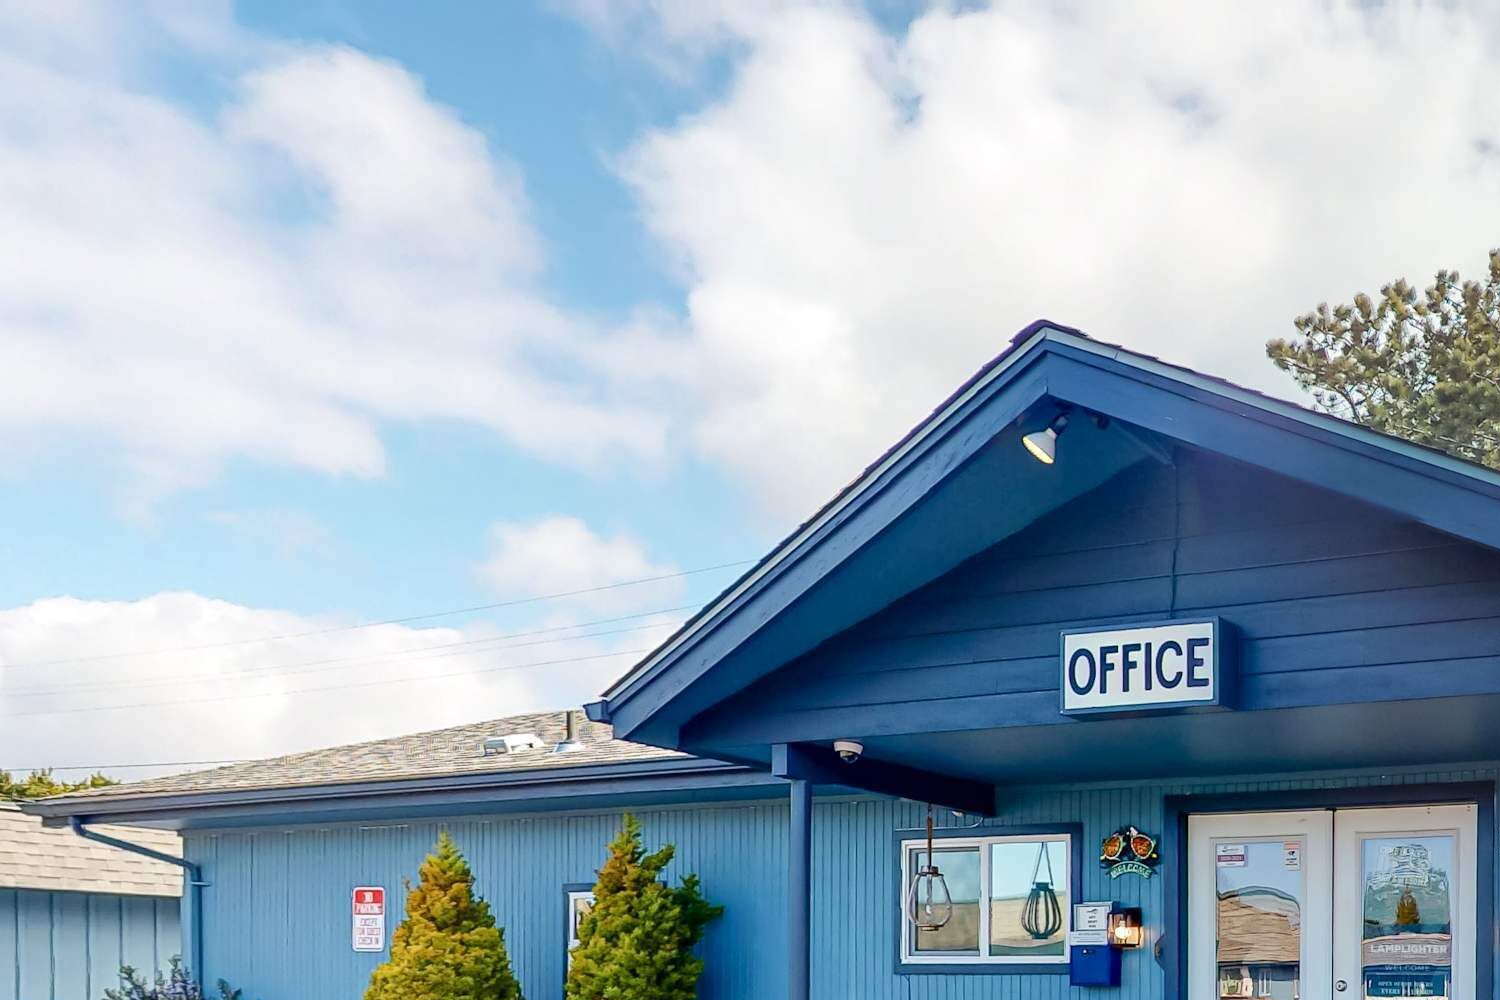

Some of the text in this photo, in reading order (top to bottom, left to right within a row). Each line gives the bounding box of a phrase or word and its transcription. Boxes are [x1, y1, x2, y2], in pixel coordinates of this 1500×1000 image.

[1069, 637, 1210, 696] OFFICE
[1111, 863, 1152, 879] WELCOME
[1370, 944, 1447, 954] LAMPLIGHTER
